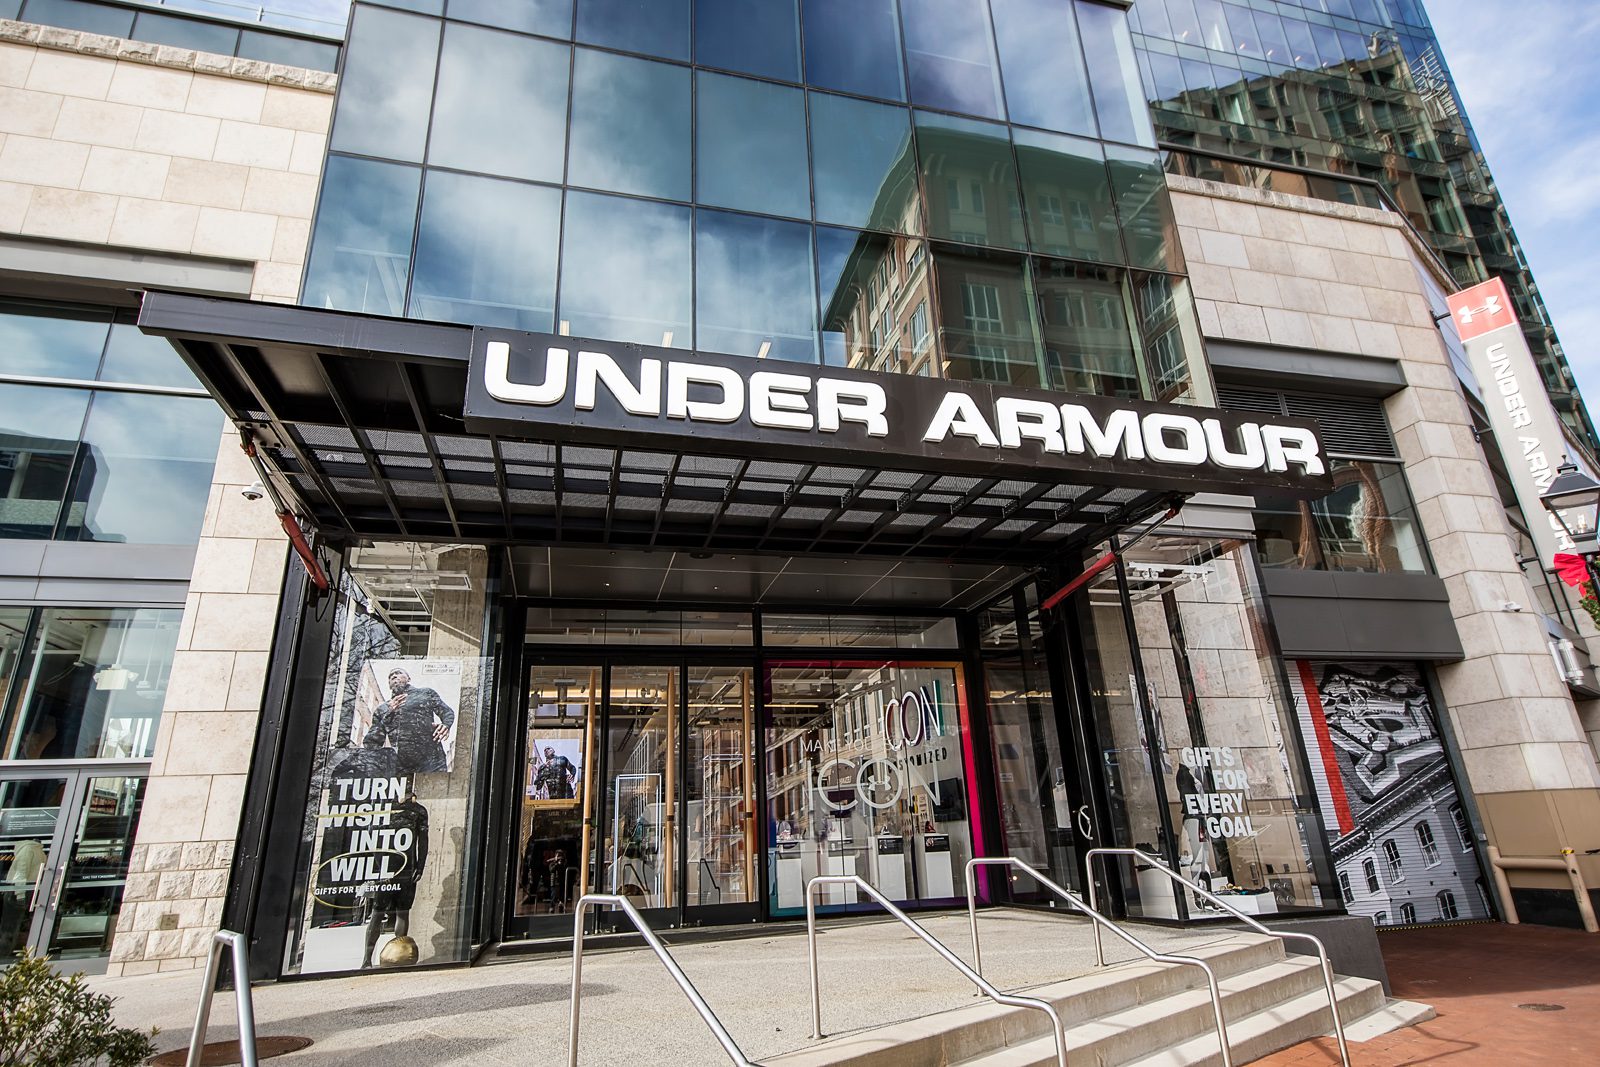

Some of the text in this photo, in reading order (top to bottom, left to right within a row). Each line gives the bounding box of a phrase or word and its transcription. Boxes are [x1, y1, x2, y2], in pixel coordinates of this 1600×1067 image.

[484, 341, 1325, 475] UNDER ARMOUR
[1486, 342, 1576, 551] UNDER ARMUR
[1181, 747, 1235, 767] GIFTS
[336, 777, 407, 802] TURN
[807, 756, 941, 812] ICON
[1212, 769, 1250, 790] FOR
[323, 803, 392, 828] WISH
[1185, 793, 1243, 815] EVERY
[1207, 816, 1257, 838] GOAL
[350, 828, 413, 853] INTO
[330, 855, 395, 881] WILL
[314, 887, 337, 895] GIFTS
[338, 886, 354, 894] FOR
[381, 883, 401, 892] GOAL
